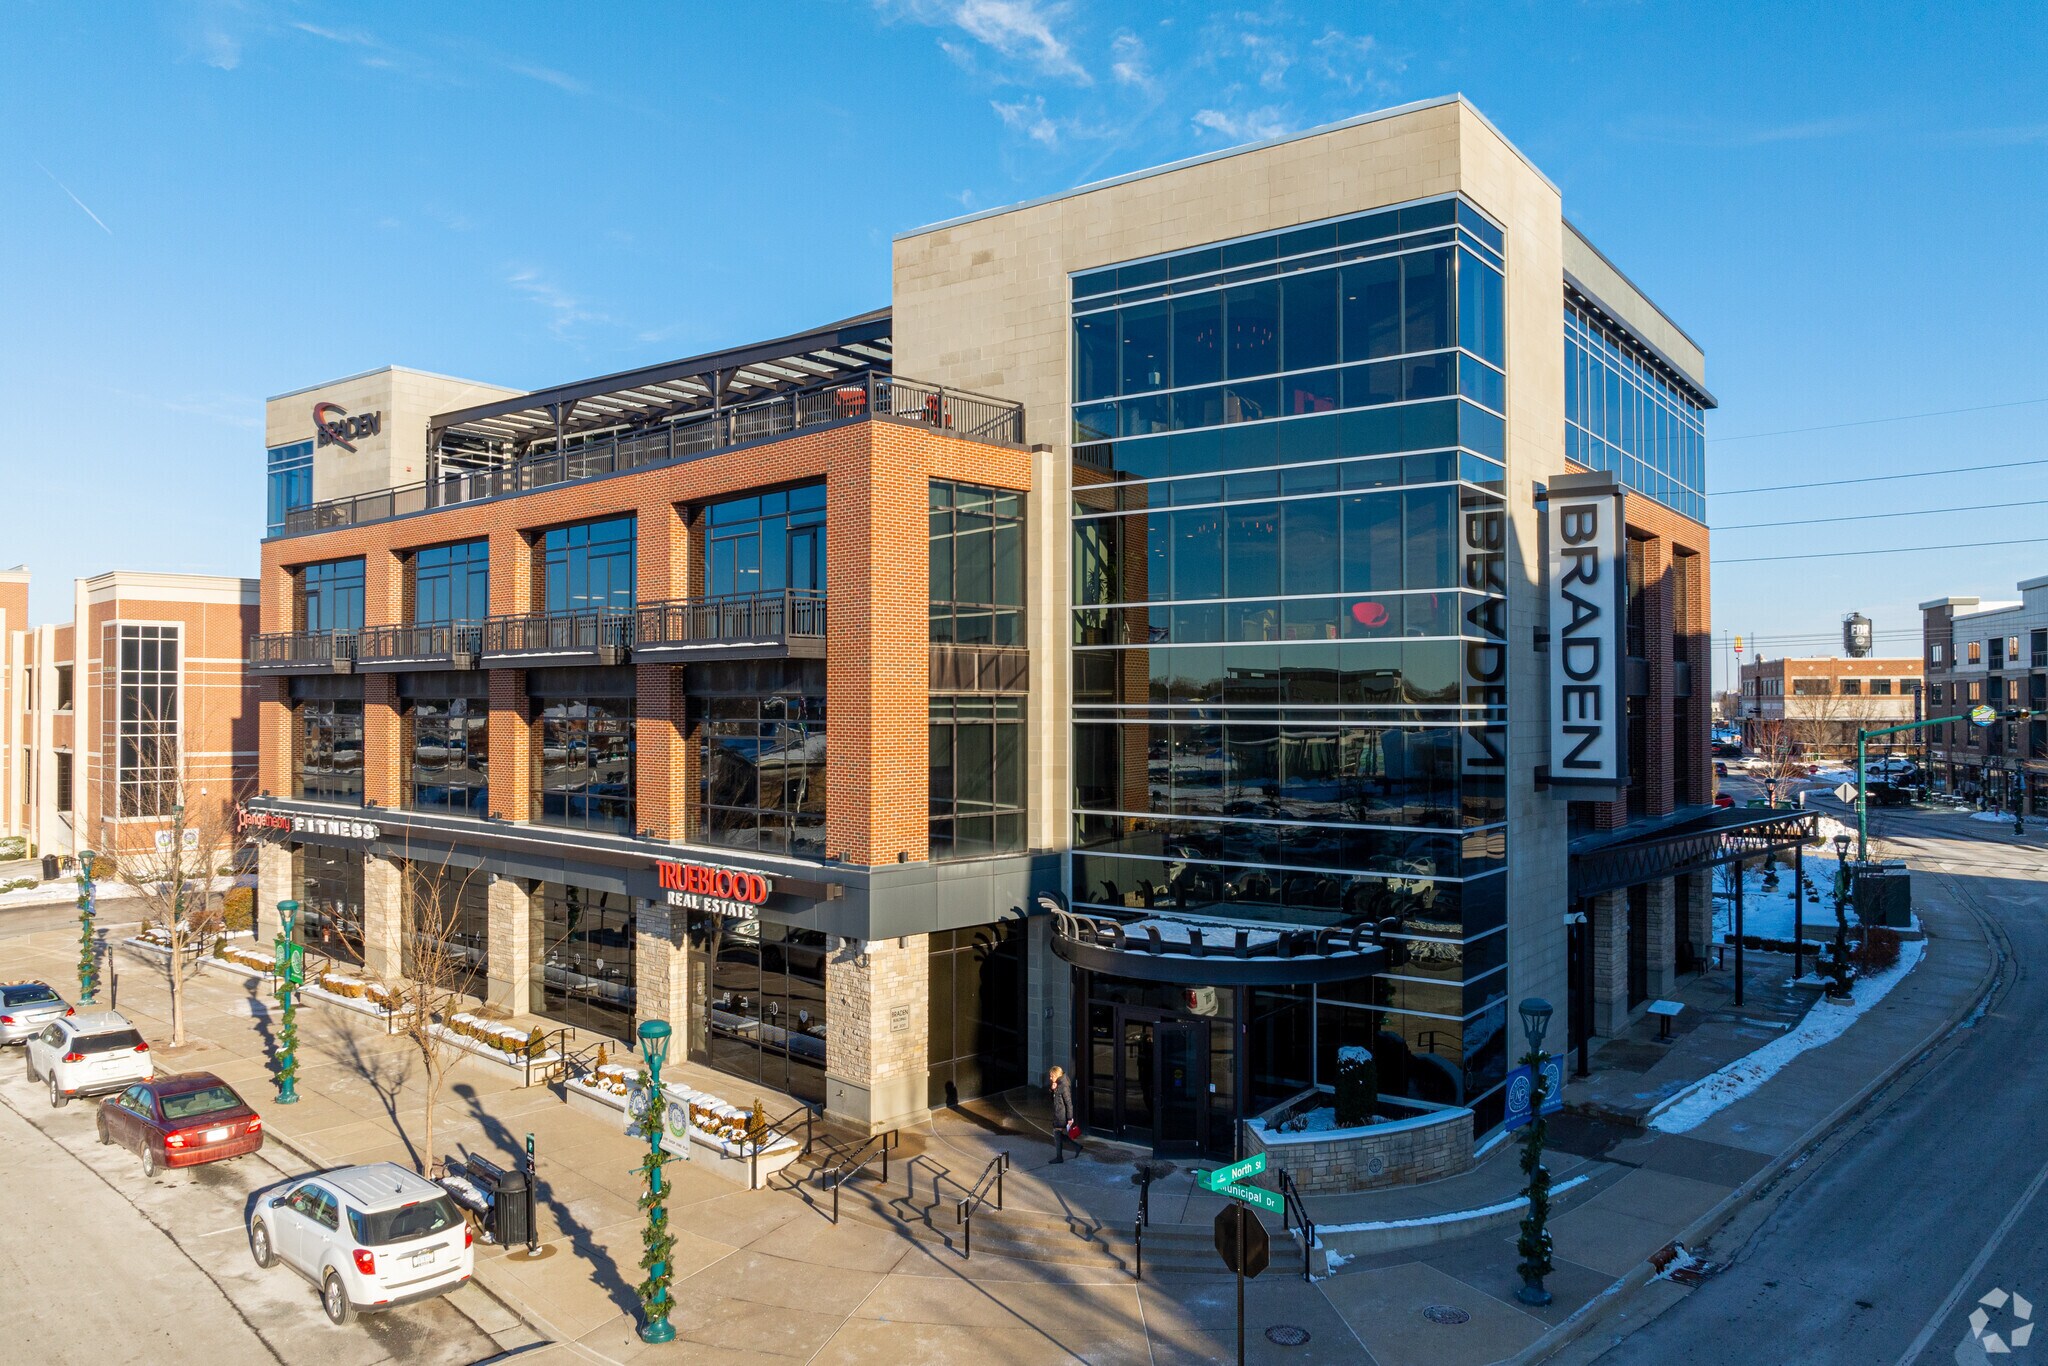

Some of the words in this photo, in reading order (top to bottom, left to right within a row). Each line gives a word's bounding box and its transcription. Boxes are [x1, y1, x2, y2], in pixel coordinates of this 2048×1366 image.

[1559, 503, 1602, 769] BRADEN
[294, 816, 376, 840] FITNESS
[656, 860, 768, 905] TRUEBLOOD
[667, 891, 700, 910] REAL
[703, 897, 755, 920] ESTATE
[1231, 1162, 1252, 1180] North
[1255, 1160, 1262, 1170] St
[1266, 1197, 1275, 1207] Dr
